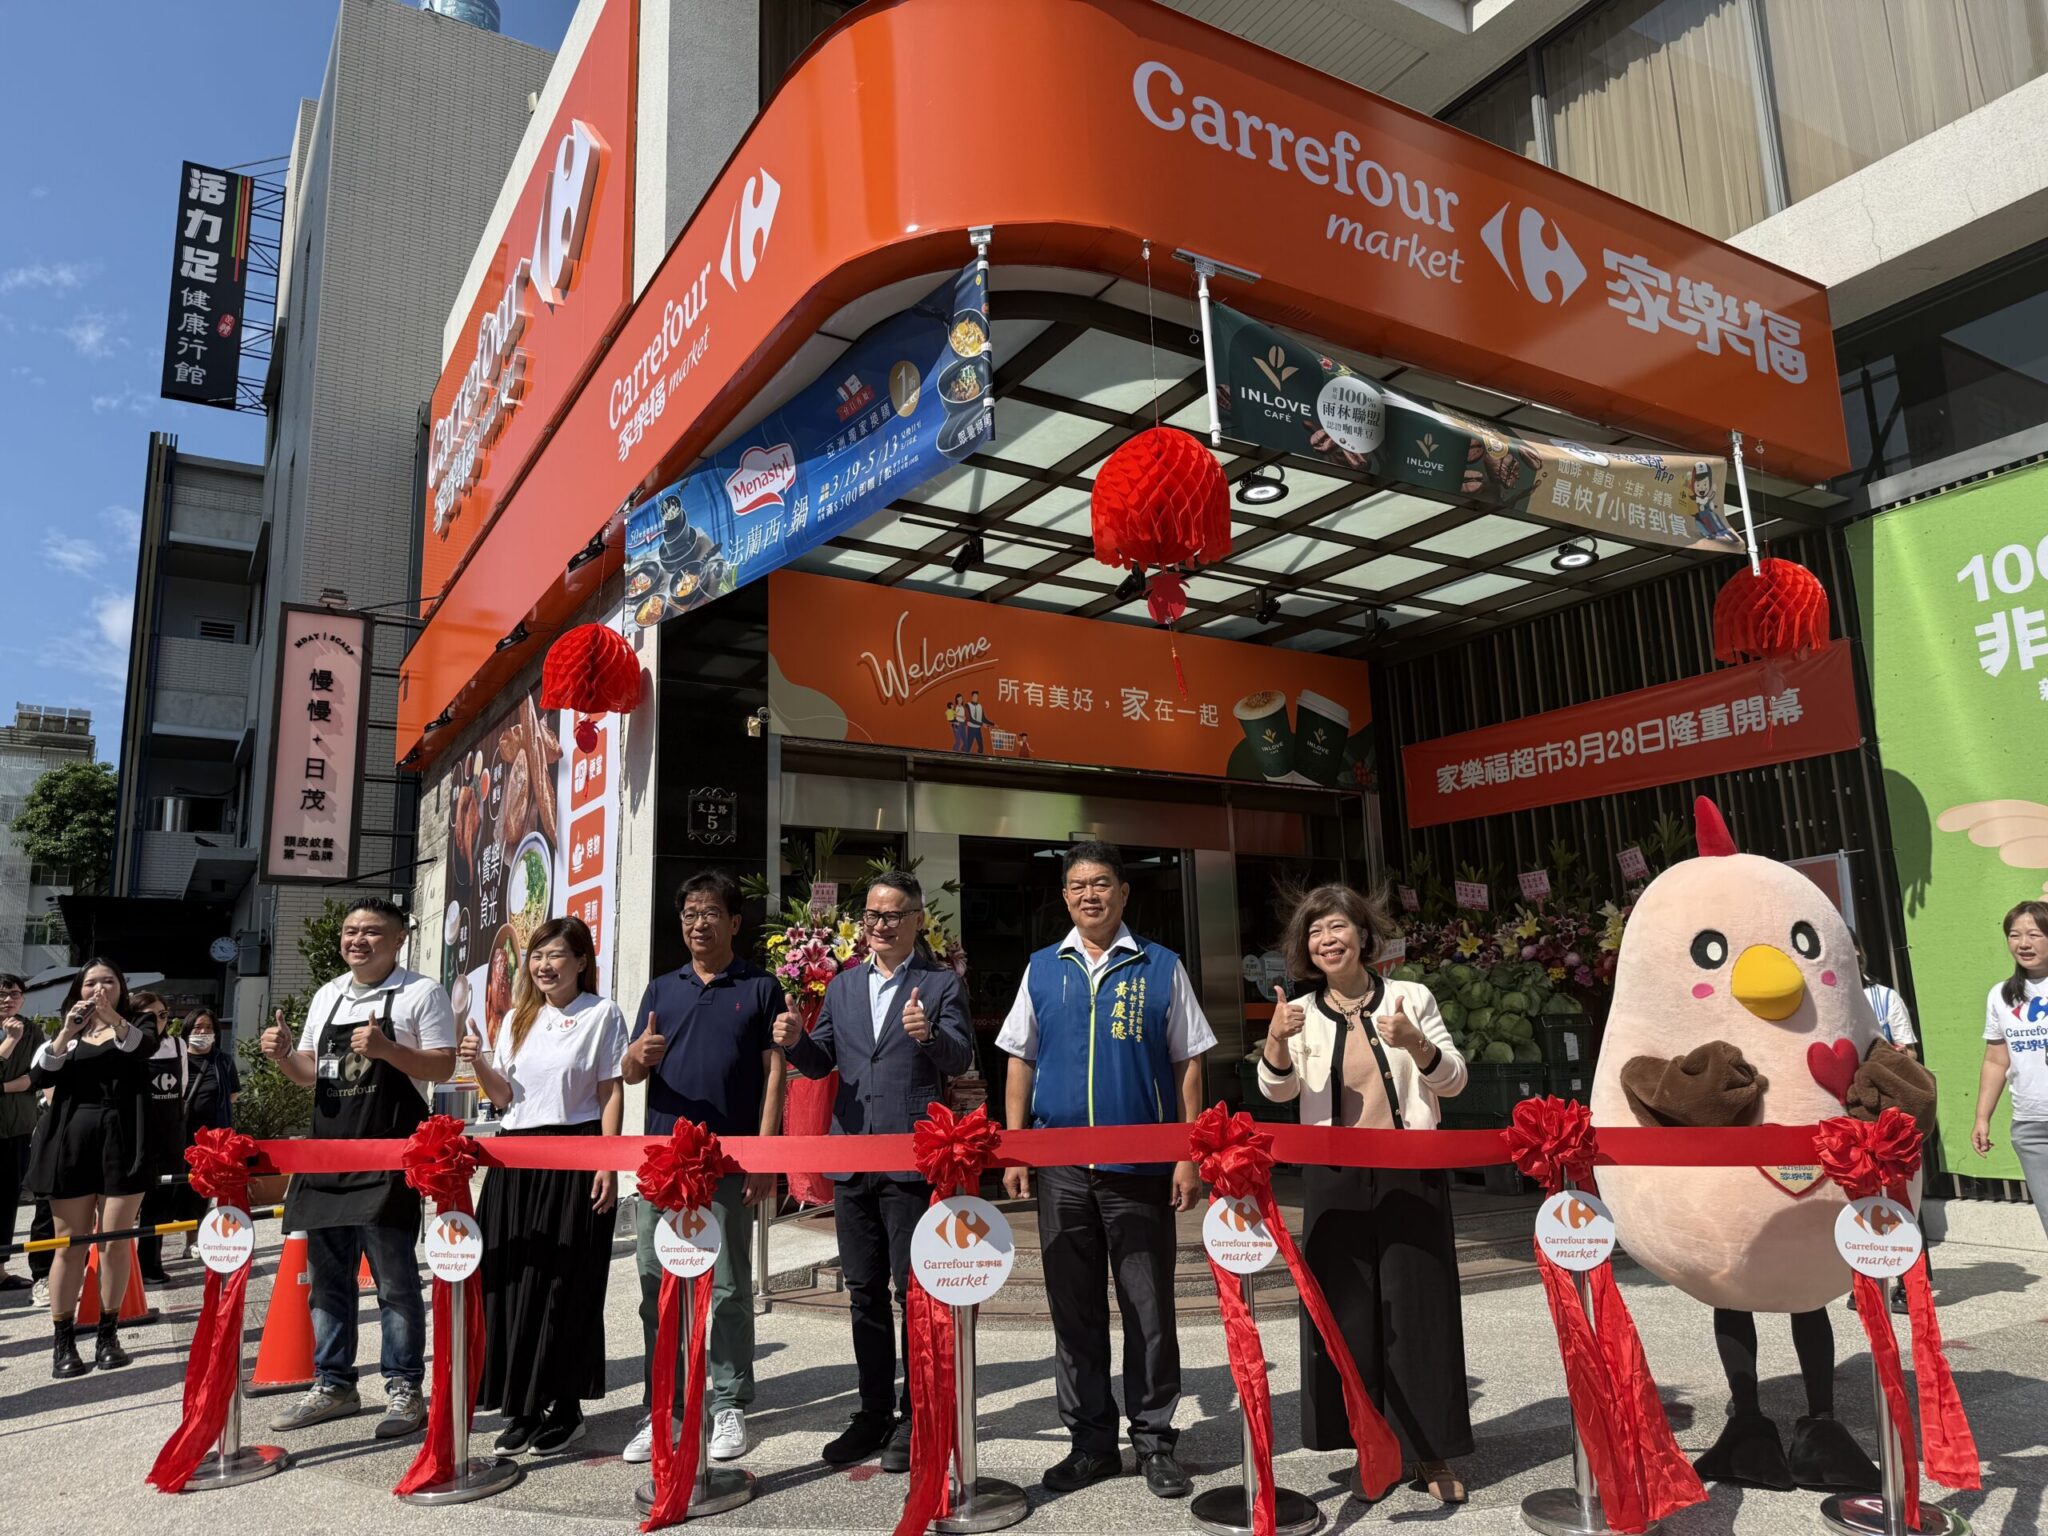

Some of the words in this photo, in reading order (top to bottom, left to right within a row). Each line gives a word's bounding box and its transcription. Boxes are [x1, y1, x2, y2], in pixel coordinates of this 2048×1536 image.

[1133, 60, 1459, 233] Carrefour
[179, 168, 227, 284] 活力足
[1326, 213, 1465, 284] market
[1602, 247, 1808, 384] 家樂福
[174, 286, 211, 386] 健康行館
[609, 261, 711, 430] Carrefour
[668, 322, 711, 397] market
[429, 257, 533, 490] Carrefour
[1241, 386, 1312, 417] INLOVE
[1339, 387, 1377, 408] 100%
[618, 374, 666, 462] 家樂福
[1264, 408, 1292, 423] CAFÉ
[1322, 401, 1380, 427] 雨林聯盟
[958, 412, 993, 445] 限量換購
[830, 434, 898, 497] 3/19-5/13
[1406, 456, 1444, 472] INLOVE
[1417, 468, 1433, 476] CAFÉ
[733, 453, 791, 502] Menastyl
[1654, 470, 1675, 485] APP
[1551, 478, 1690, 538] 最快1小時到貨
[1974, 606, 2048, 677] 非
[861, 611, 991, 699] Welcome
[307, 668, 334, 722] 慢慢
[998, 677, 1220, 728] 所有美好，家在一起
[1436, 687, 1804, 794] 家樂福超市3月28日隆重開幕
[300, 757, 326, 811] 日茂
[707, 815, 718, 830] 5
[2005, 1026, 2048, 1038] Carrefo
[326, 1084, 377, 1097] Carrefour
[203, 1243, 232, 1251] Carrefour
[661, 1245, 695, 1253] Carrefour
[1211, 1238, 1251, 1247] Carrefour
[1545, 1236, 1586, 1244] Carrefour
[1845, 1241, 1890, 1252] Carrefour
[209, 1254, 240, 1264] market
[429, 1250, 460, 1259] Carrefour
[669, 1256, 705, 1267] market
[1221, 1251, 1263, 1262] market
[1556, 1248, 1598, 1259] market
[1857, 1255, 1903, 1267] market
[436, 1262, 467, 1272] market
[923, 1259, 974, 1270] Carrefour
[936, 1273, 990, 1288] market
